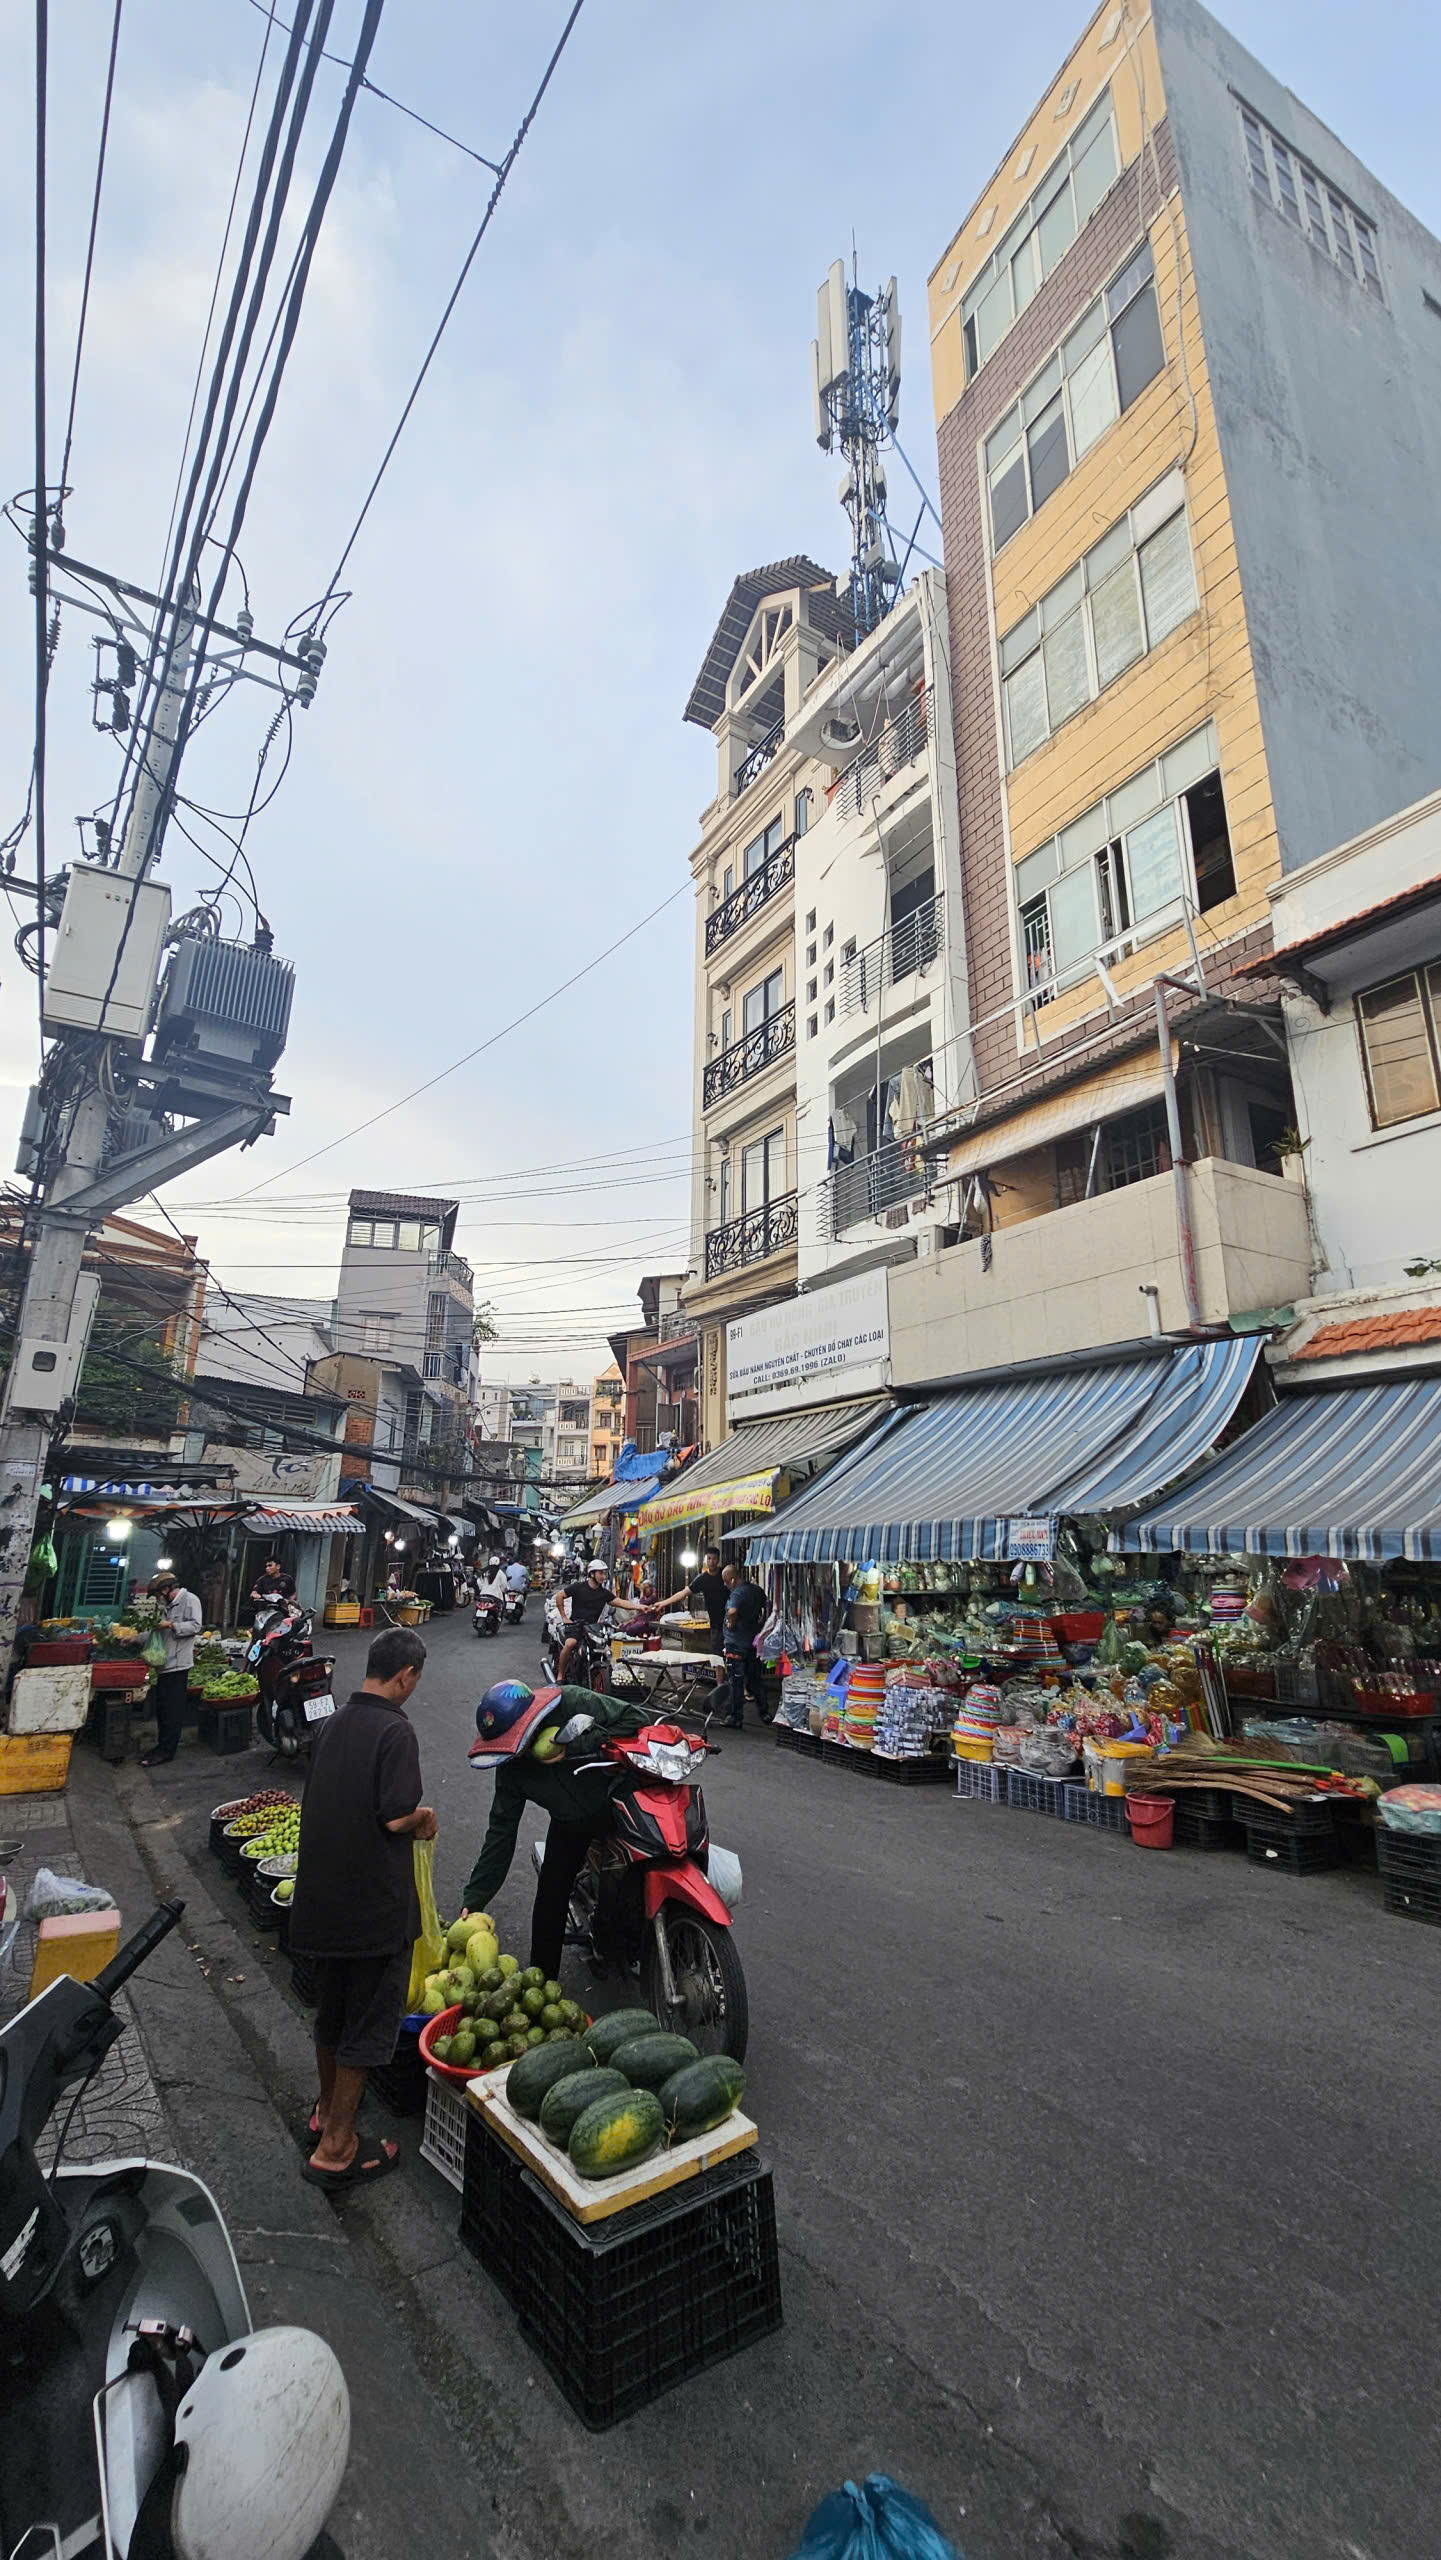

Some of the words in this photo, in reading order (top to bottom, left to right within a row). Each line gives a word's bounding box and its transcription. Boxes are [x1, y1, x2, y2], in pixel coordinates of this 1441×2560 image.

[837, 1337, 853, 1350] CHAY
[854, 1333, 868, 1345] CÁC
[868, 1329, 884, 1342] LOẠI
[753, 1373, 771, 1385] CALL:
[820, 1353, 846, 1367] (ZALO)
